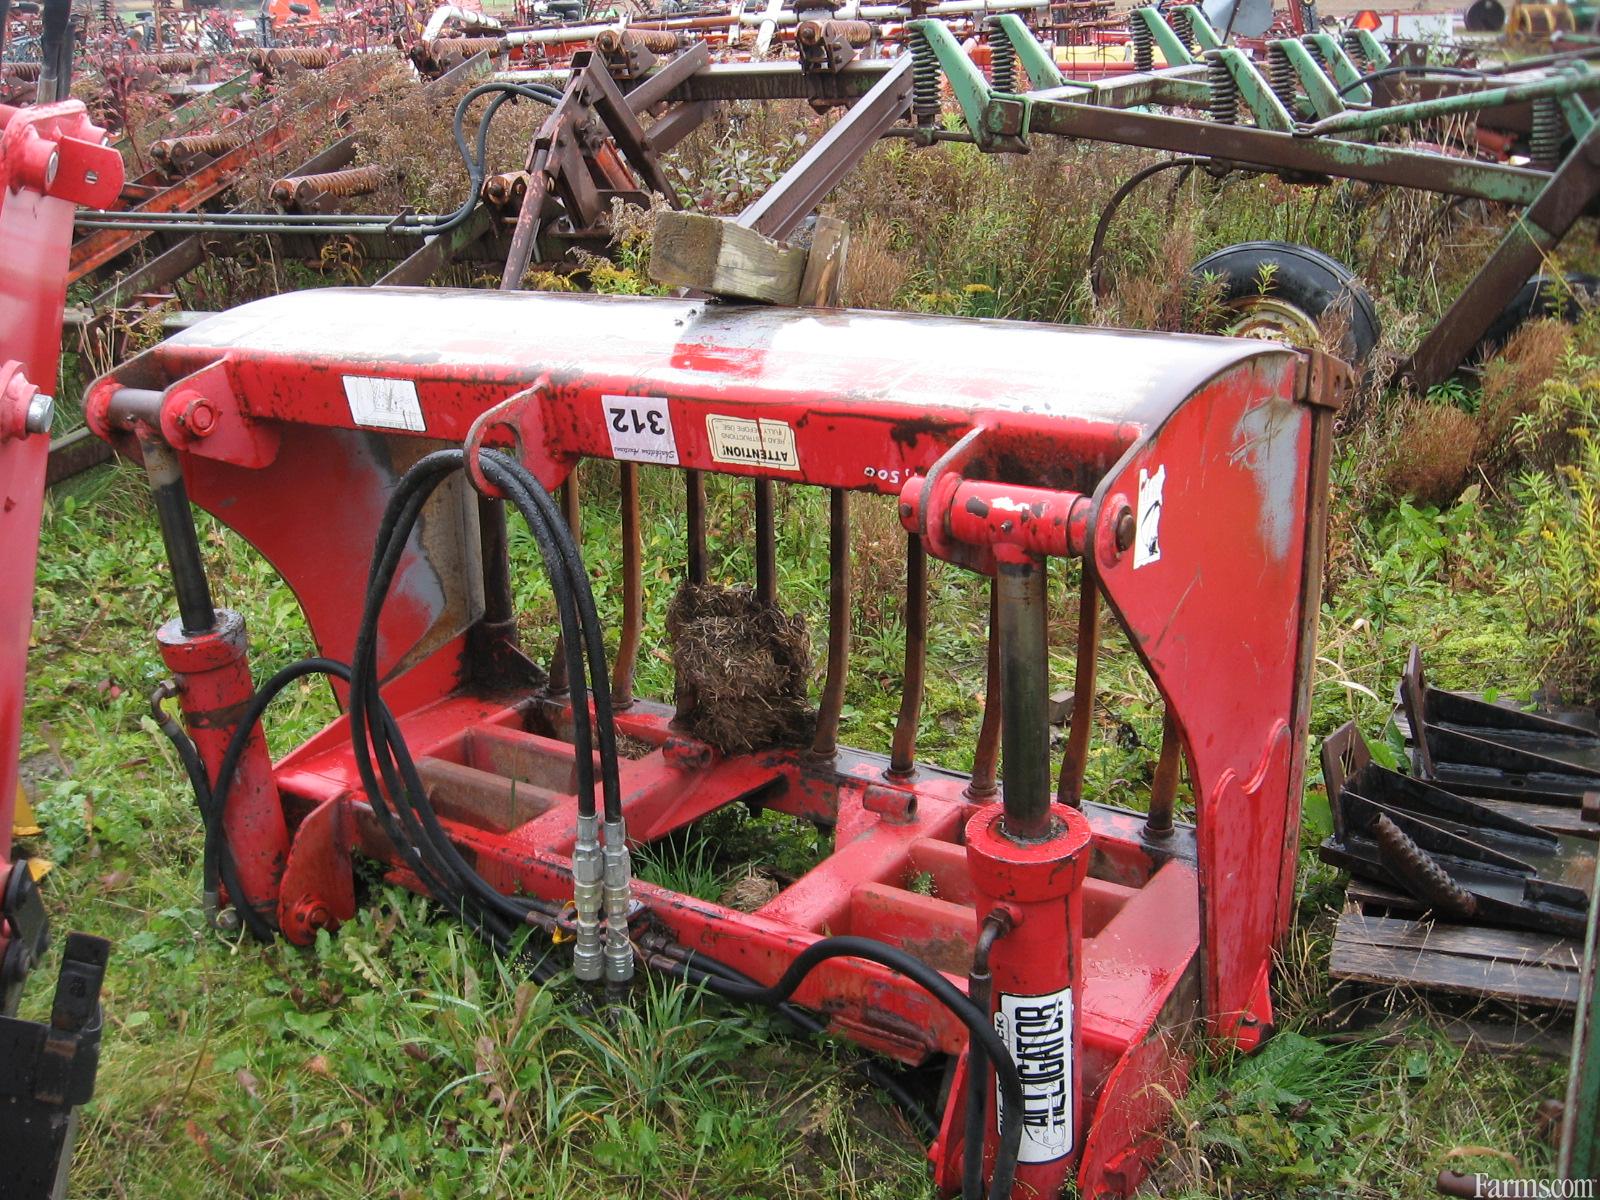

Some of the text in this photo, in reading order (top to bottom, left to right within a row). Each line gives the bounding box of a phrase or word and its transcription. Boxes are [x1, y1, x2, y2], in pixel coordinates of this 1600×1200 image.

[609, 407, 665, 435] 312
[722, 444, 788, 462] ATTENTION!
[1014, 1001, 1065, 1127] ALLIGATOR
